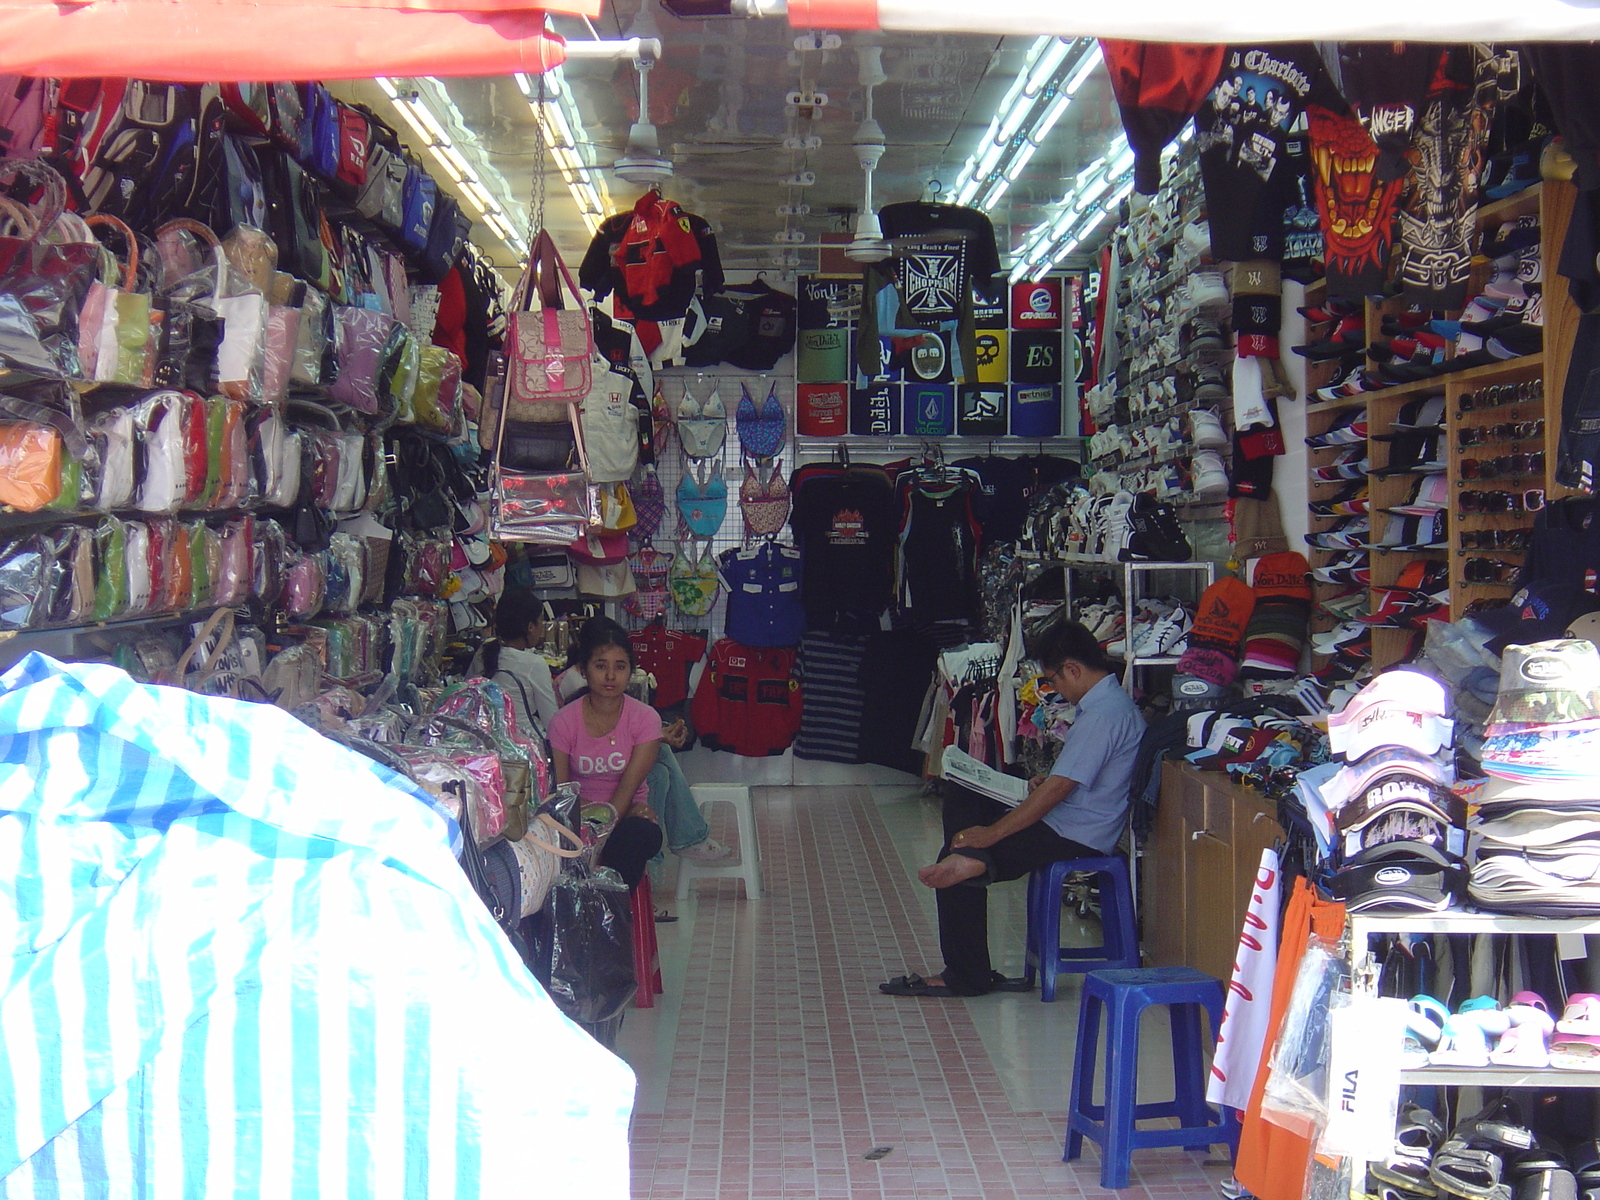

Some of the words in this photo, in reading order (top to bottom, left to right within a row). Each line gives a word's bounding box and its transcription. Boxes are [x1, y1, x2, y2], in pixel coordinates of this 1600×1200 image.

[1276, 572, 1307, 586] Dutc
[578, 751, 626, 774] D&G
[1341, 1068, 1359, 1113] FILA
